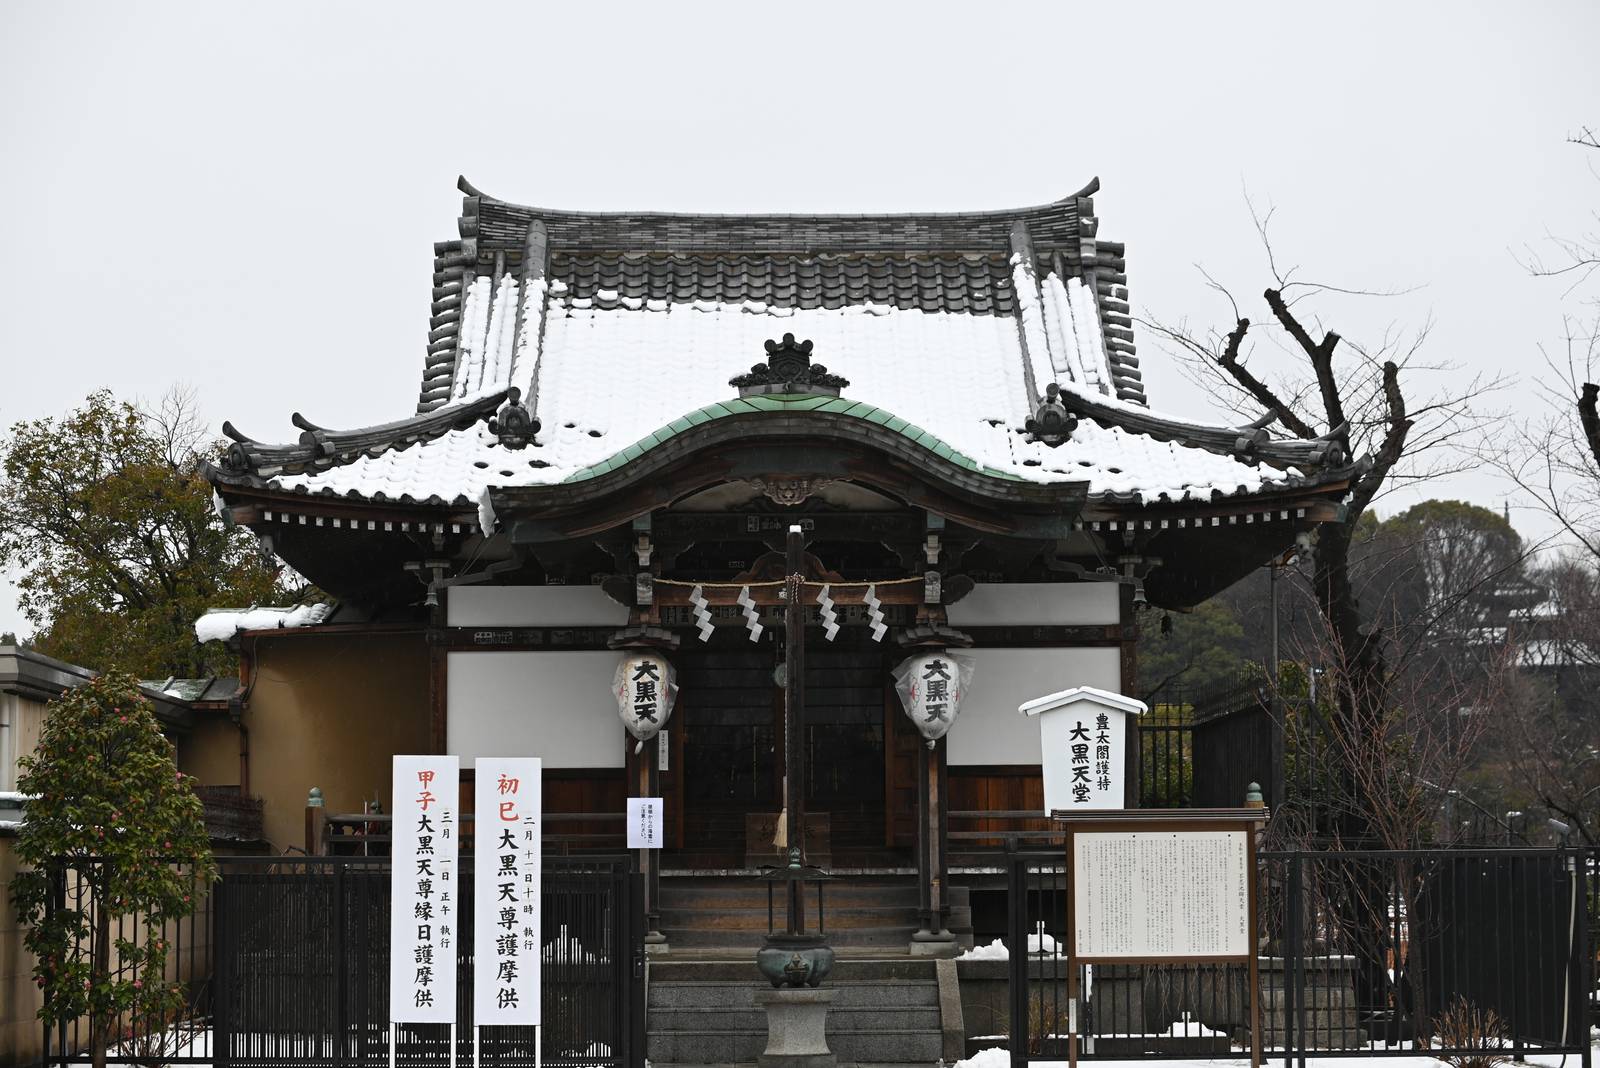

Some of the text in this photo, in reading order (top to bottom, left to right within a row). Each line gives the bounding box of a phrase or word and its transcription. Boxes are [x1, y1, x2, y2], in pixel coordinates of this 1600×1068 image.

[632, 661, 660, 724] 大黒天
[922, 659, 951, 723] 大黒天
[1069, 721, 1093, 803] 大黒天堂
